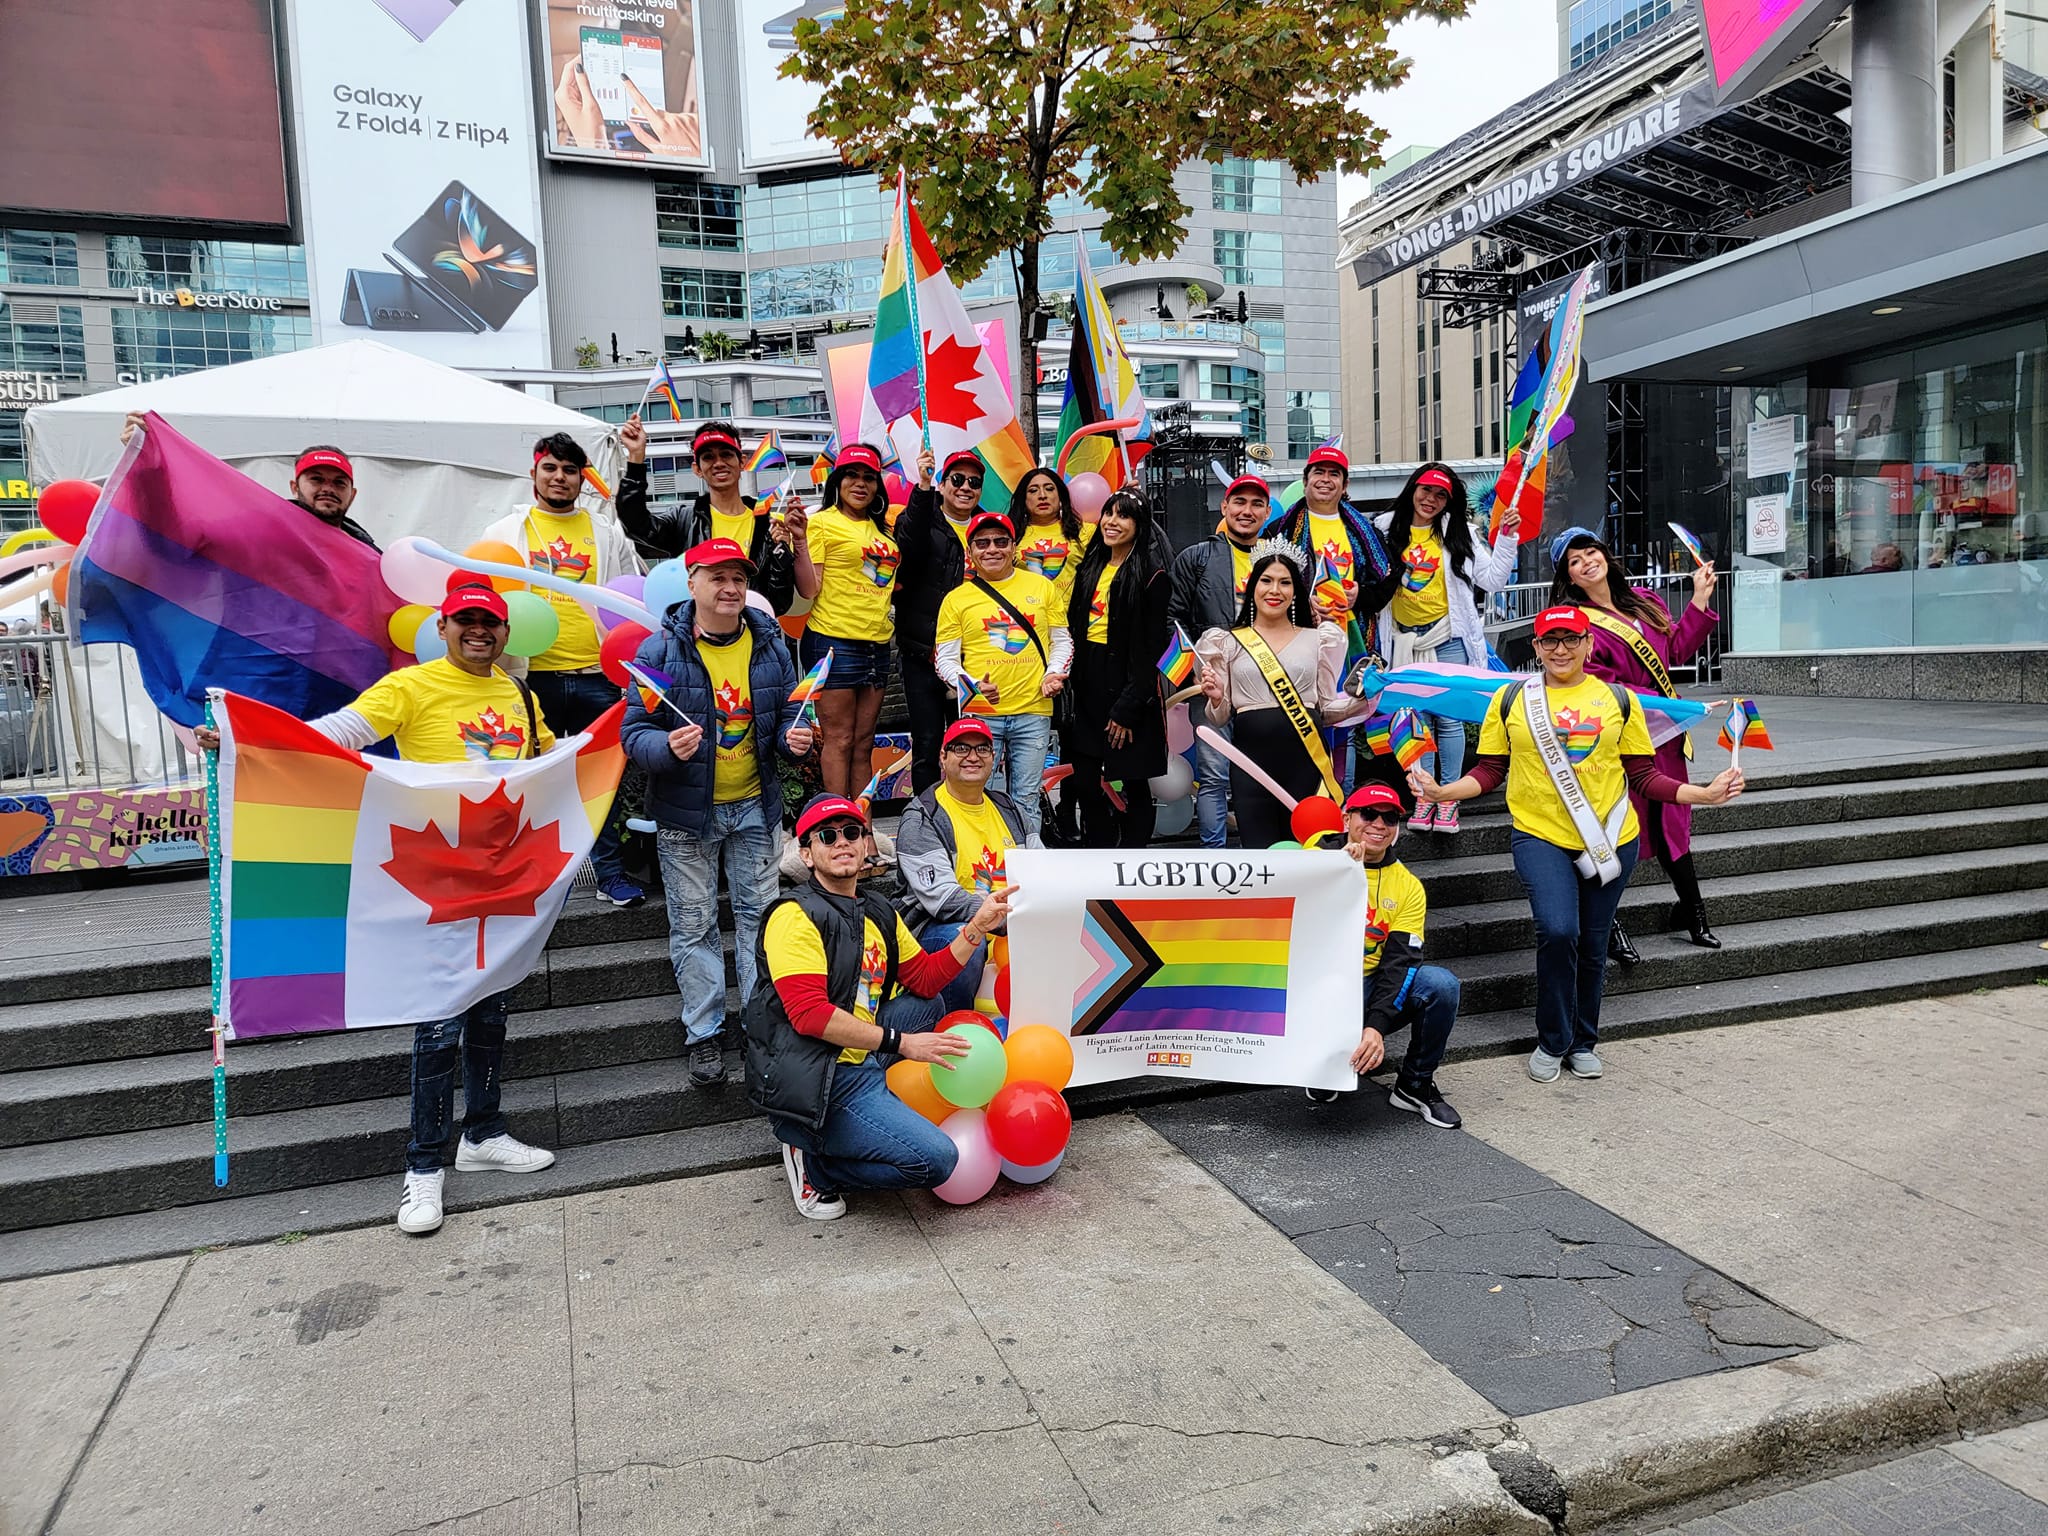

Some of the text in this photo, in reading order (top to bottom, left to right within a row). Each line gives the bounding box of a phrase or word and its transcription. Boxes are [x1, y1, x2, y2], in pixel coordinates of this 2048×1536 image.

[576, 3, 665, 28] multitasking
[333, 84, 423, 115] Galaxy
[336, 111, 510, 148] Z Fold4 Z Flip4
[1385, 96, 1683, 268] YONGE-DUNDAS SQUARE
[131, 286, 282, 311] The Beer Store
[462, 594, 490, 602] Canada
[1634, 640, 1673, 696] COLOMBIA
[1273, 677, 1313, 738] CANADA
[1530, 698, 1562, 766] MARCHIONESS
[1556, 769, 1585, 813] GLOBAL
[822, 803, 848, 811] Canada
[1370, 790, 1393, 799] Canada
[137, 809, 202, 831] hello
[1113, 861, 1275, 895] LGBTQ2+
[1086, 1037, 1121, 1047] Hispanic
[1129, 1034, 1151, 1042] Latin
[1152, 1033, 1193, 1041] American
[1195, 1033, 1233, 1045] Heritage
[1236, 1036, 1265, 1047] Month
[1096, 1042, 1253, 1055] La Fiesta of Latin American Cultures
[1148, 1054, 1190, 1064] HCHC
